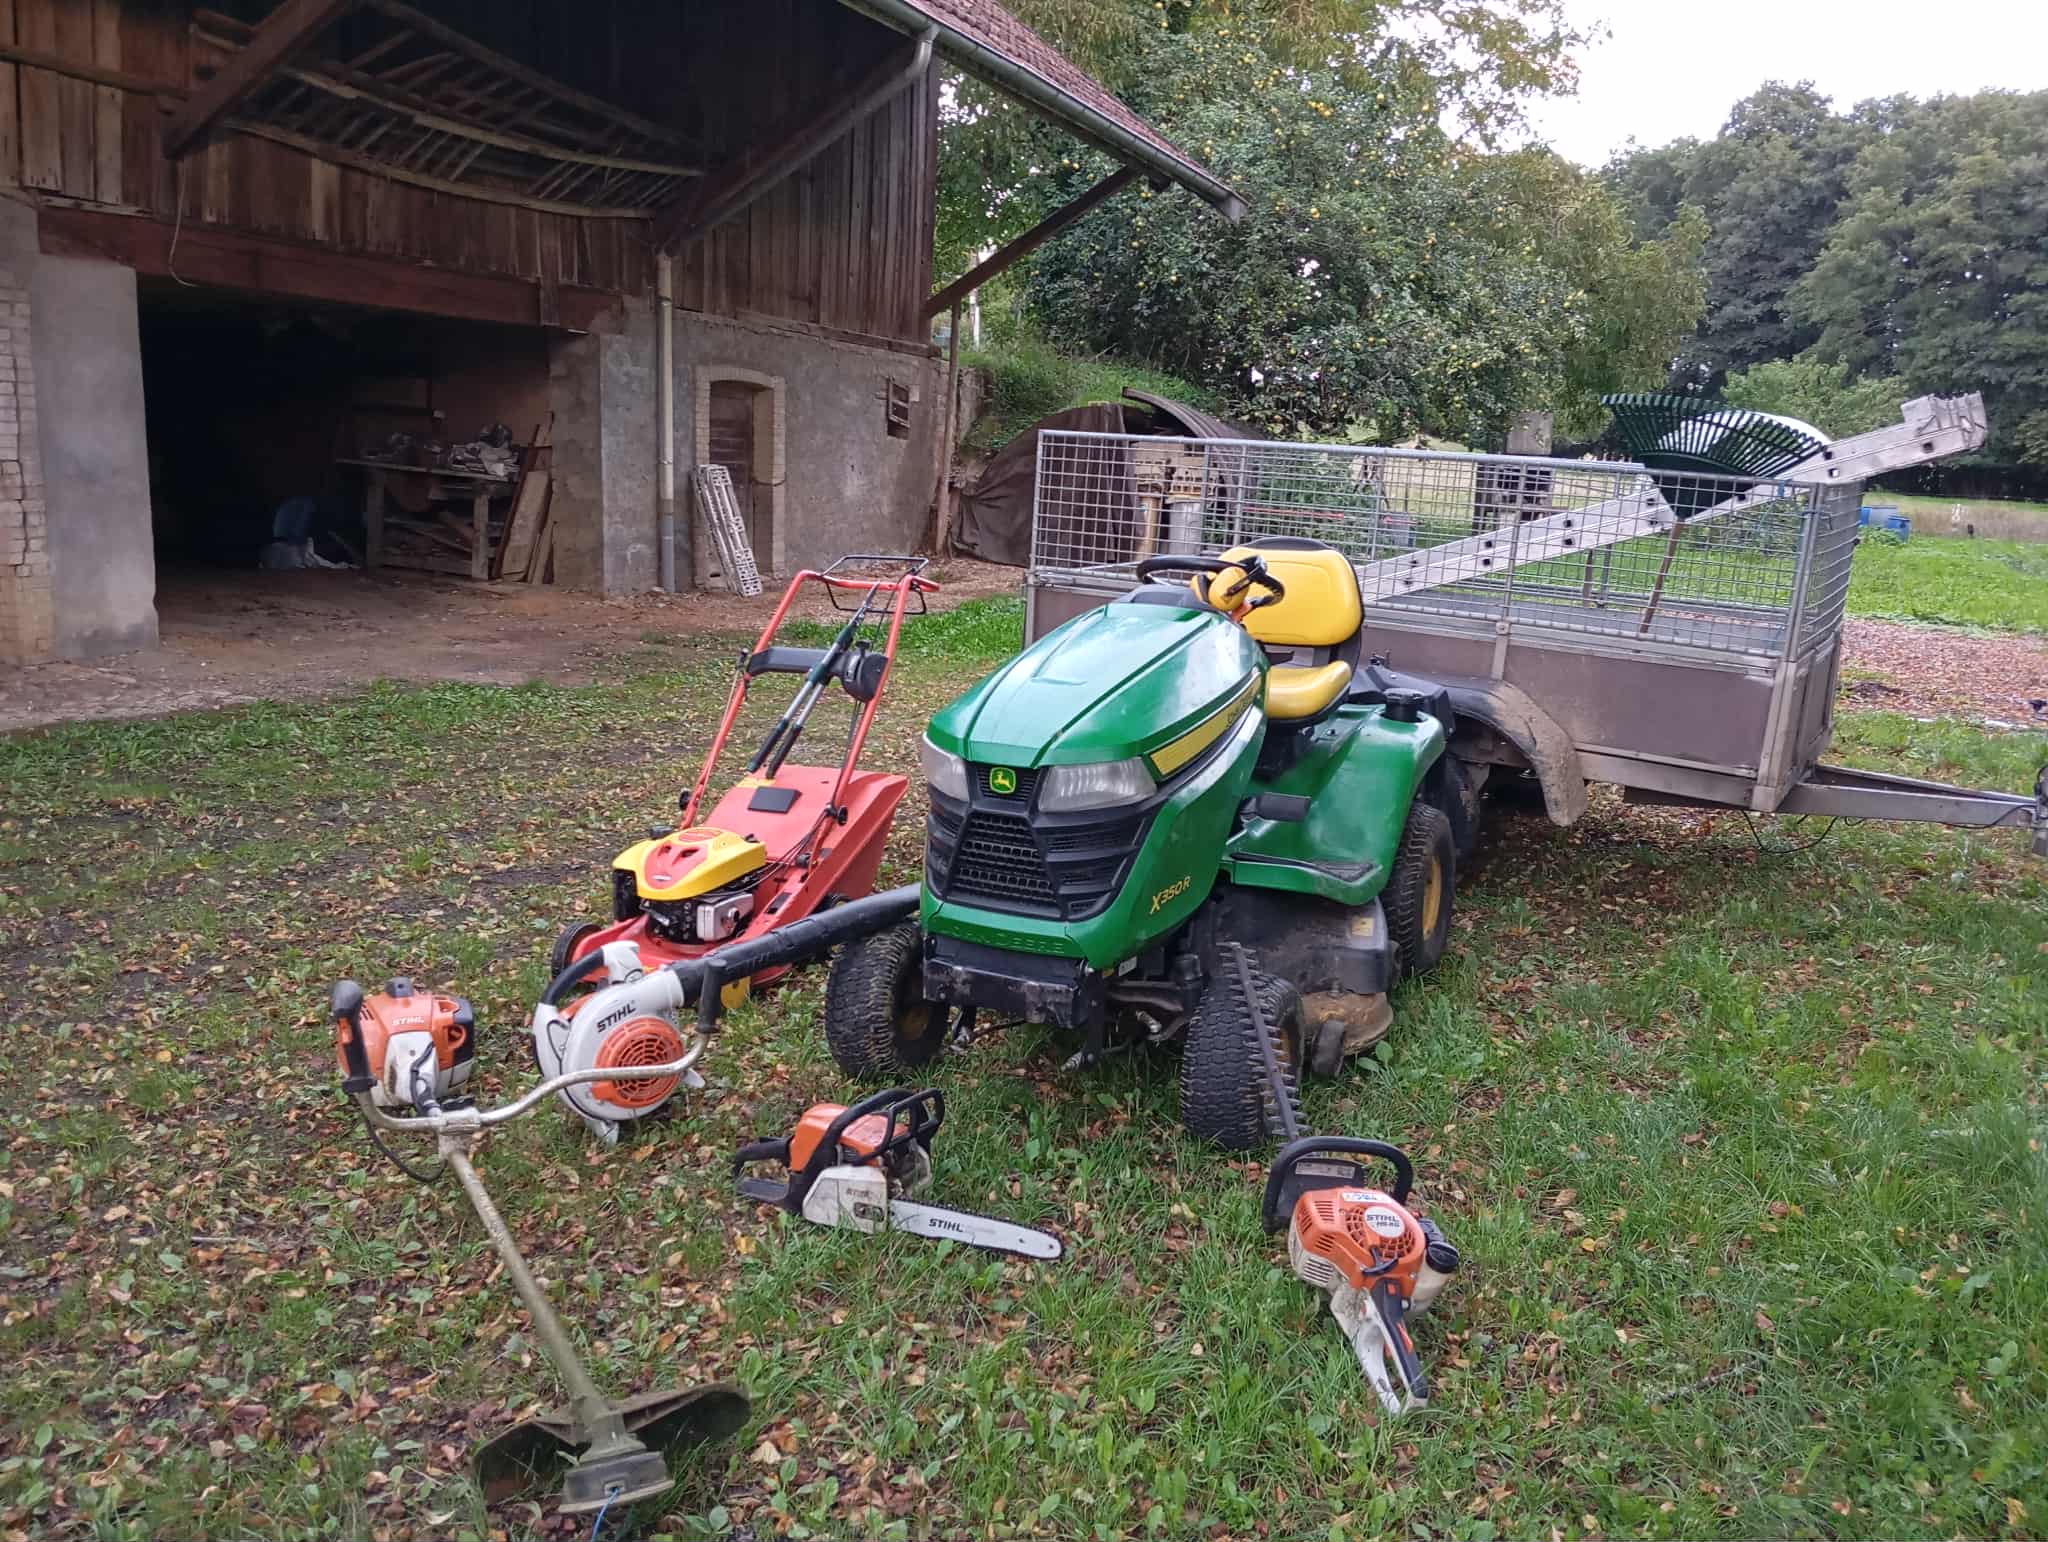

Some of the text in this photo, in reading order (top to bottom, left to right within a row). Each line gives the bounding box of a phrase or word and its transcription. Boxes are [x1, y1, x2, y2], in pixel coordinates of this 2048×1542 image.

[1149, 875, 1191, 915] X350R
[596, 1006, 636, 1034] STIHL
[928, 1218, 964, 1233] STIHL
[1366, 1214, 1399, 1223] STIHL
